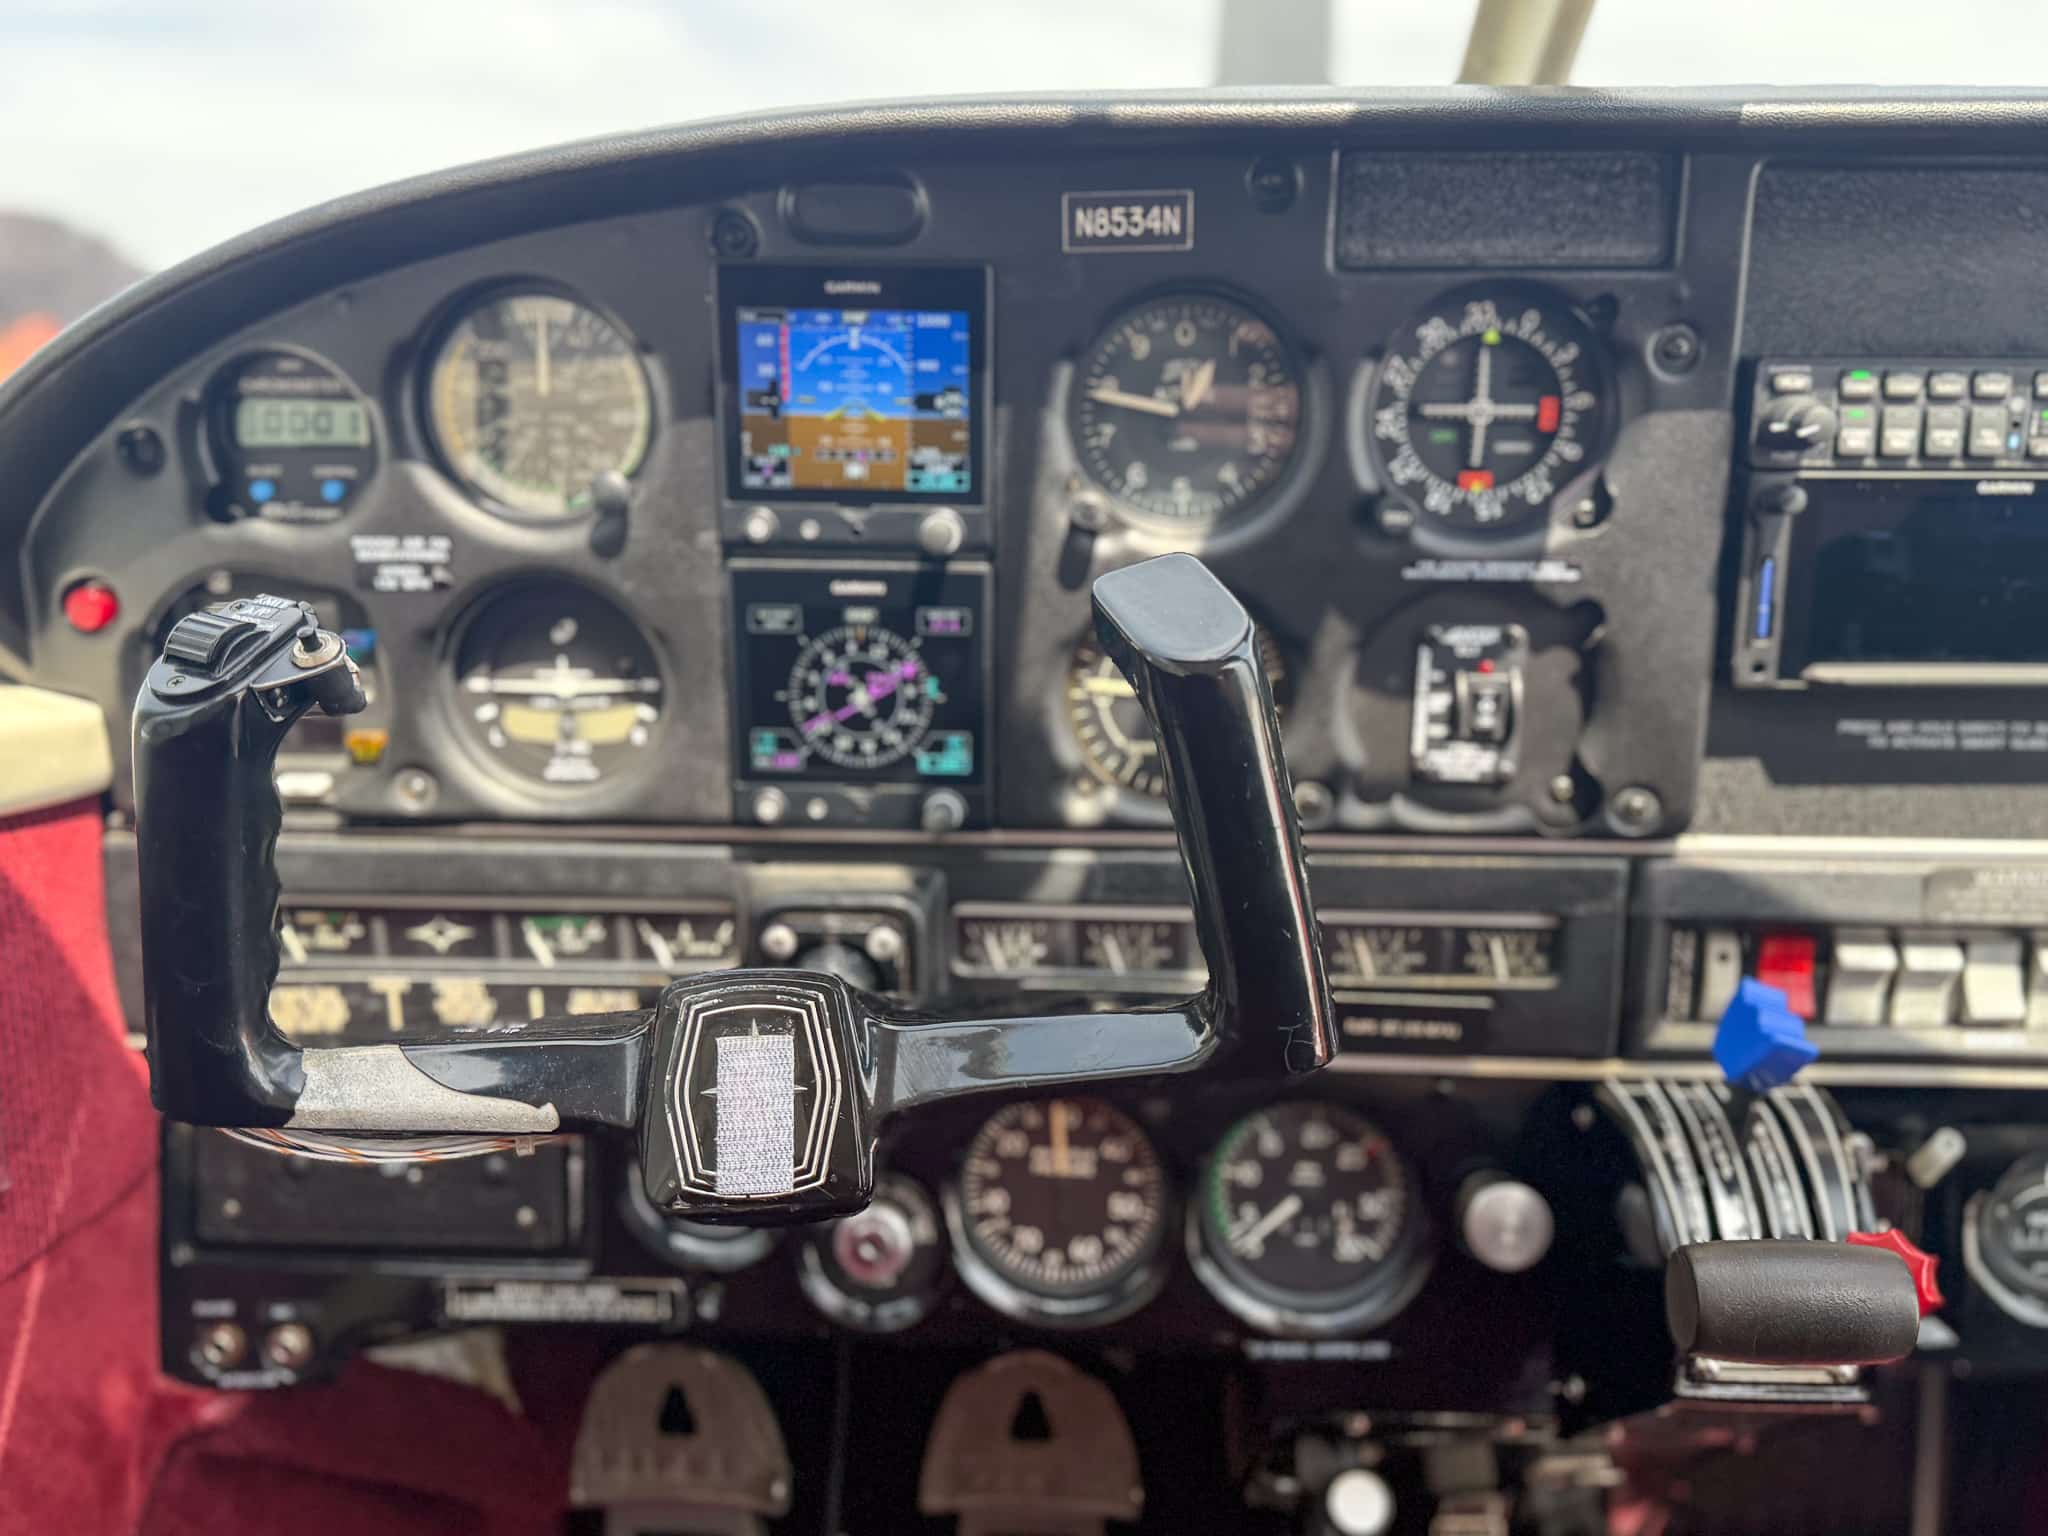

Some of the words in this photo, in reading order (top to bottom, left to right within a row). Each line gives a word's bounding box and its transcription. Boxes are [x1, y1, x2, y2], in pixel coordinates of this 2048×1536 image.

[1075, 205, 1181, 237] N8534N
[1130, 334, 1150, 360] 9
[1175, 319, 1197, 347] 0
